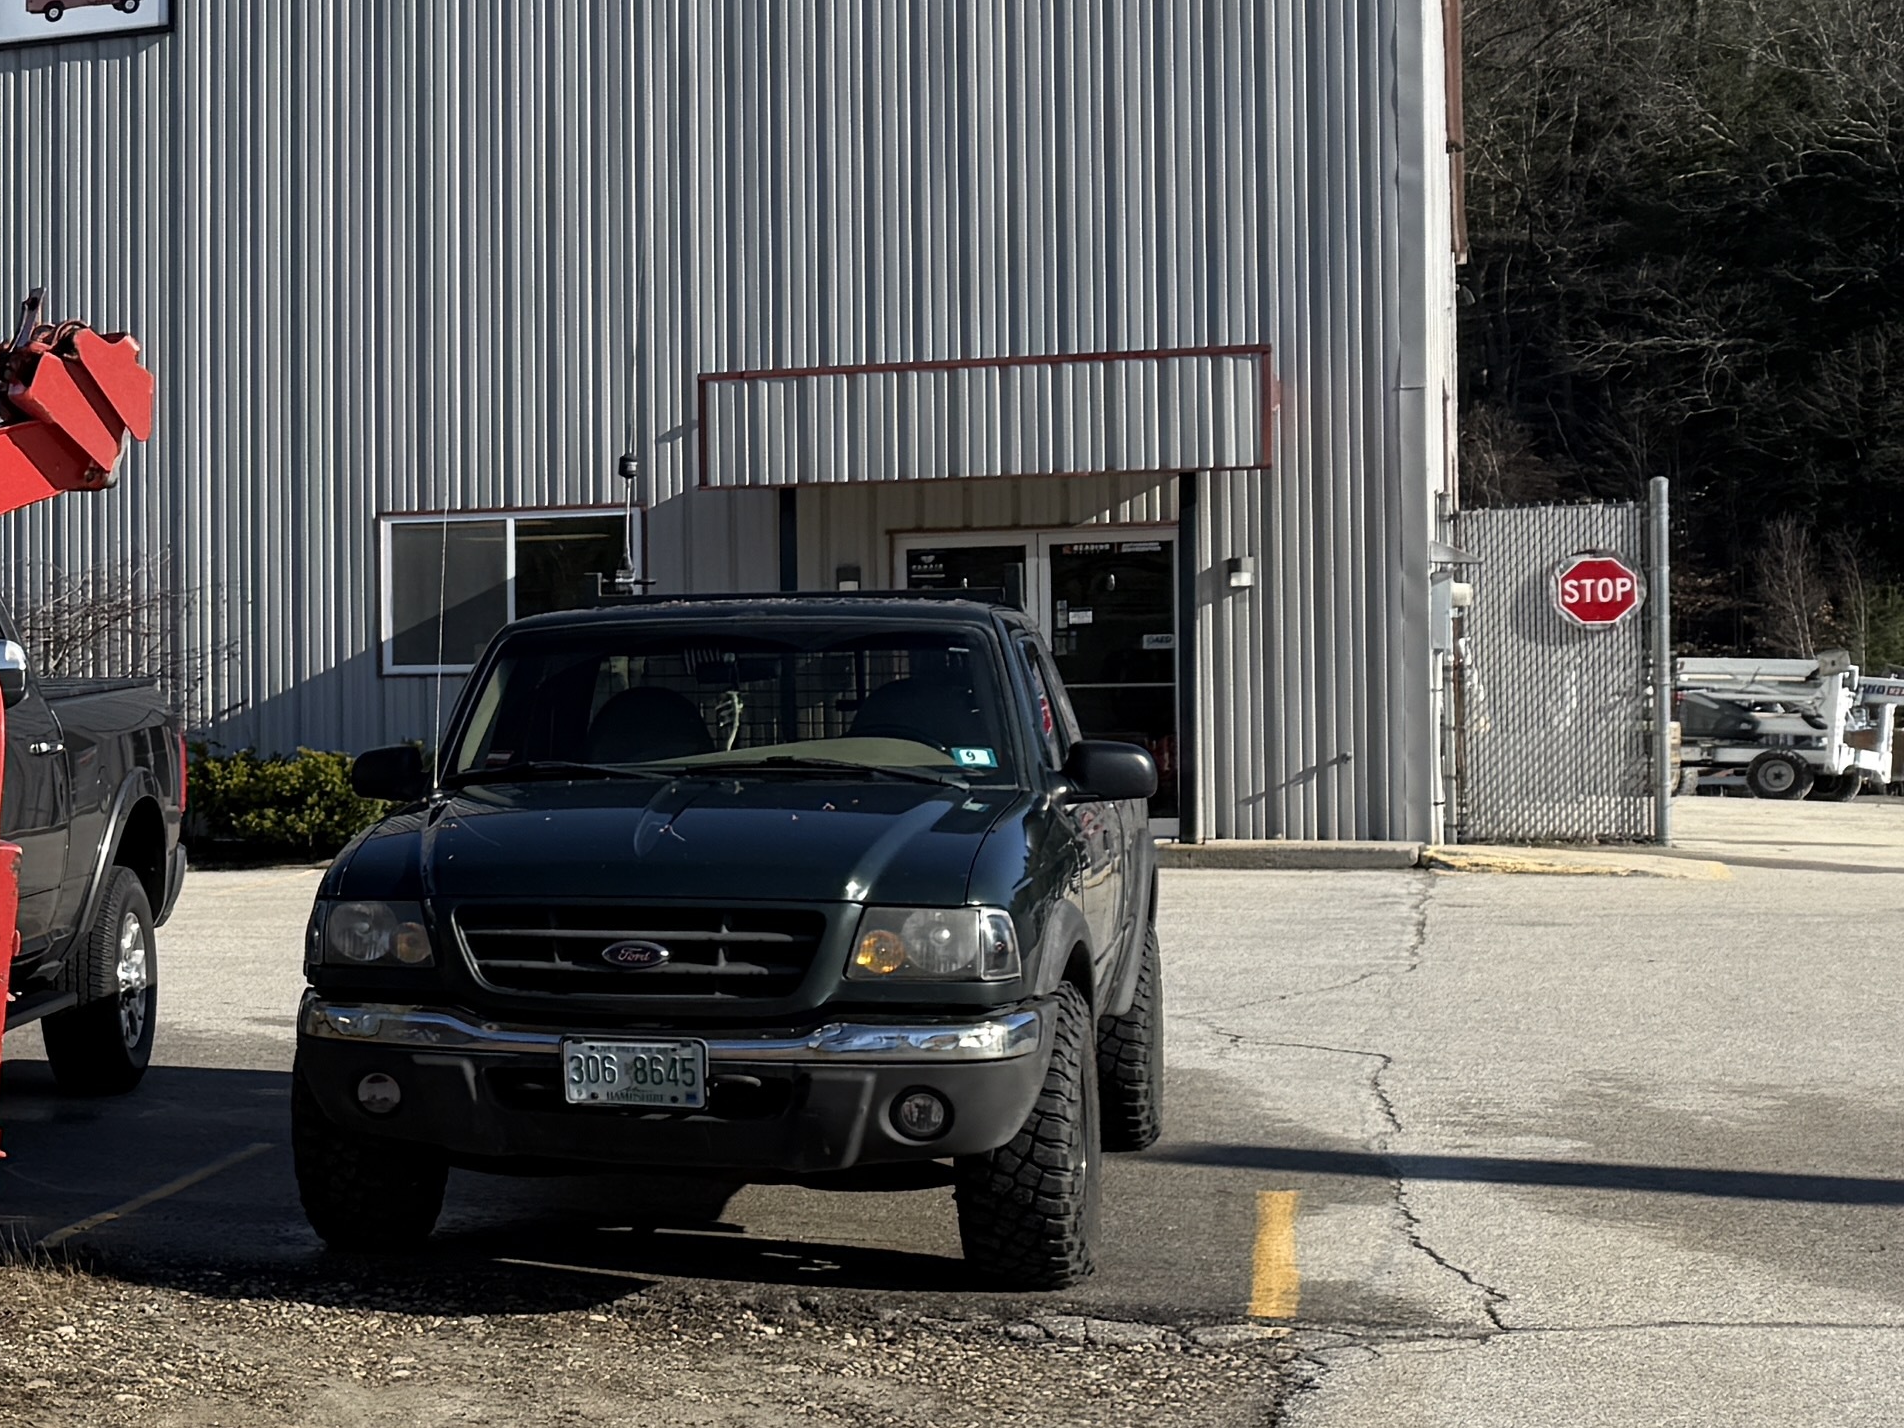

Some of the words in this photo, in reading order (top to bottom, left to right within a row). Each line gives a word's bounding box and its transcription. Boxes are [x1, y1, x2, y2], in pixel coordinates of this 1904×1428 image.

[1563, 577, 1632, 604] STOP
[618, 947, 651, 961] Ford
[569, 1053, 618, 1084] 306
[633, 1054, 696, 1087] 8645
